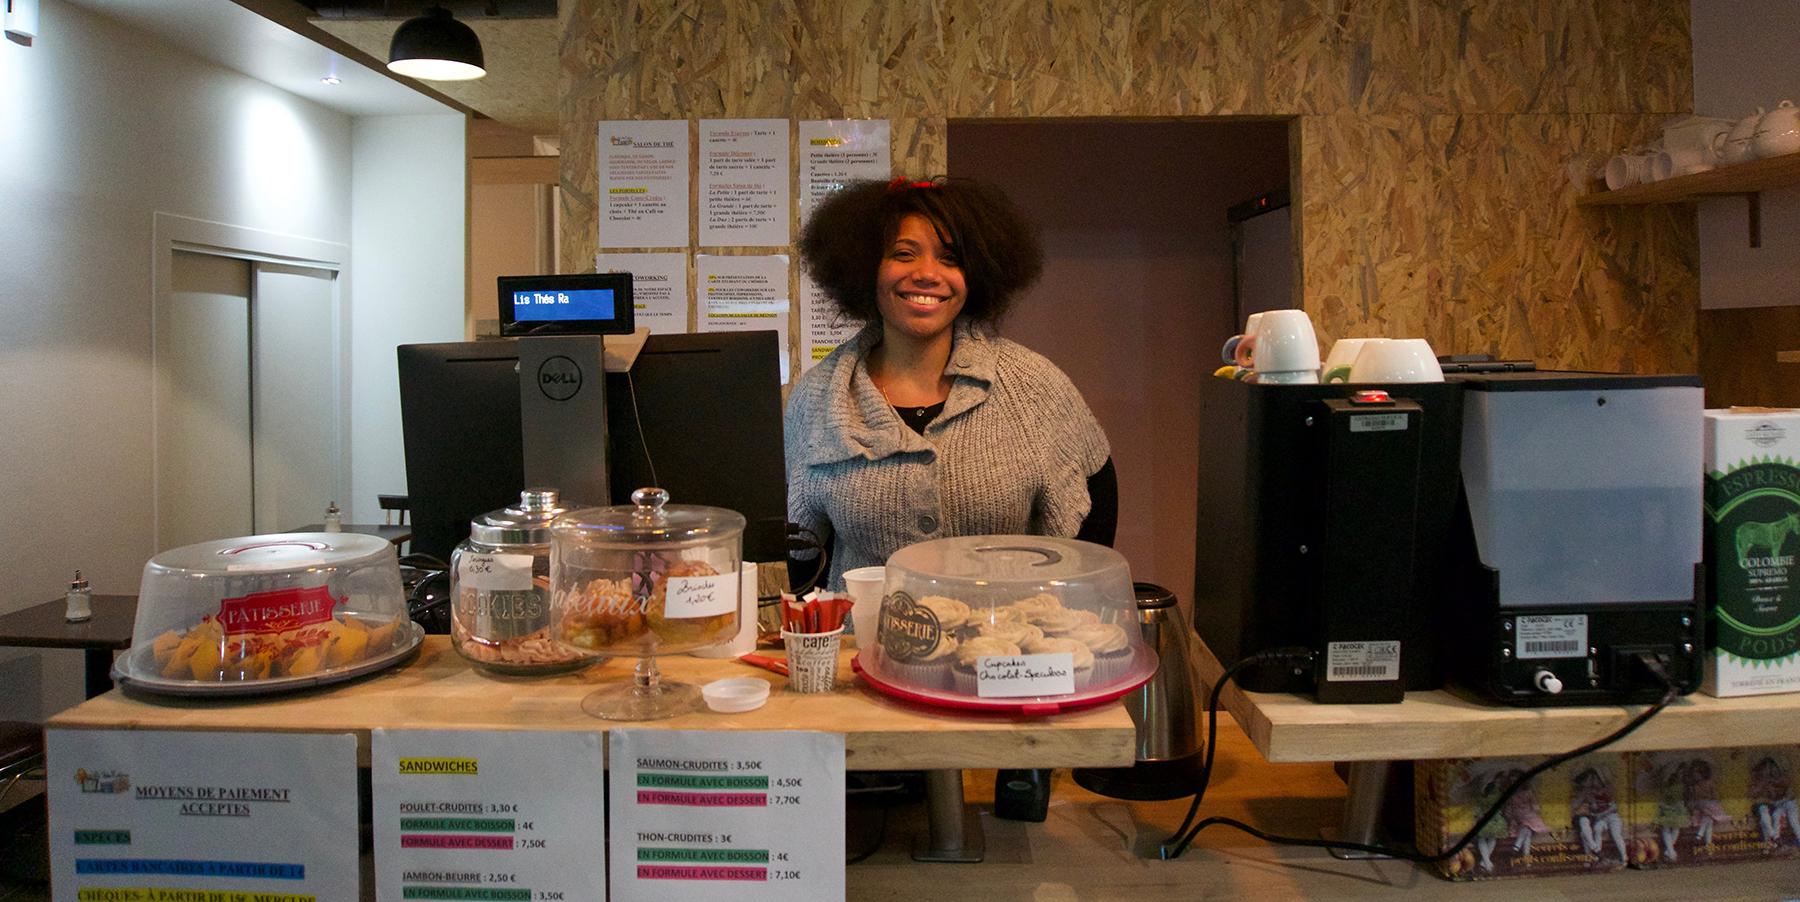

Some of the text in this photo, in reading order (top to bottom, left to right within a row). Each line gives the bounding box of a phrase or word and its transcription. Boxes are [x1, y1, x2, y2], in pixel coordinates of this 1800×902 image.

[514, 293, 569, 305] Lis Thés Ra
[542, 372, 577, 384] DELL
[1739, 555, 1795, 568] COLOMBIE
[399, 760, 478, 772] SANDWICHES
[637, 758, 762, 770] SAUMON-CRUDITES 3,50€
[637, 775, 803, 788] EN FORMULE AVEC BOISSON 4,50€
[136, 786, 290, 800] MOYENS DE PAIEMENT
[637, 792, 801, 805] EN FORMULE AVEC DESSERT 7,70€
[179, 803, 250, 815] ACCEPTES
[400, 803, 518, 813] POULET-CRUDITES 3,30 €
[400, 819, 534, 831] FORMULE AVEC BOISSON 4€
[401, 836, 546, 849] FORMULE AVEC DESSERT 7,50€
[637, 832, 732, 843] THON-CRUDITES 3€
[637, 849, 789, 862] EN FORMULE AVEC BOISSON 4€
[131, 860, 204, 874] BANCAIRES
[219, 863, 267, 876] PARTIR
[637, 867, 801, 880] EN FORMULE AVEC DESSERT 7,10€
[403, 872, 516, 883] JAMBON-BEURRE 2,50 €
[159, 891, 202, 902] PARTIR
[209, 892, 226, 902] DE
[403, 887, 564, 901] EN FORMULE AVEC BOISSON 3,50€
